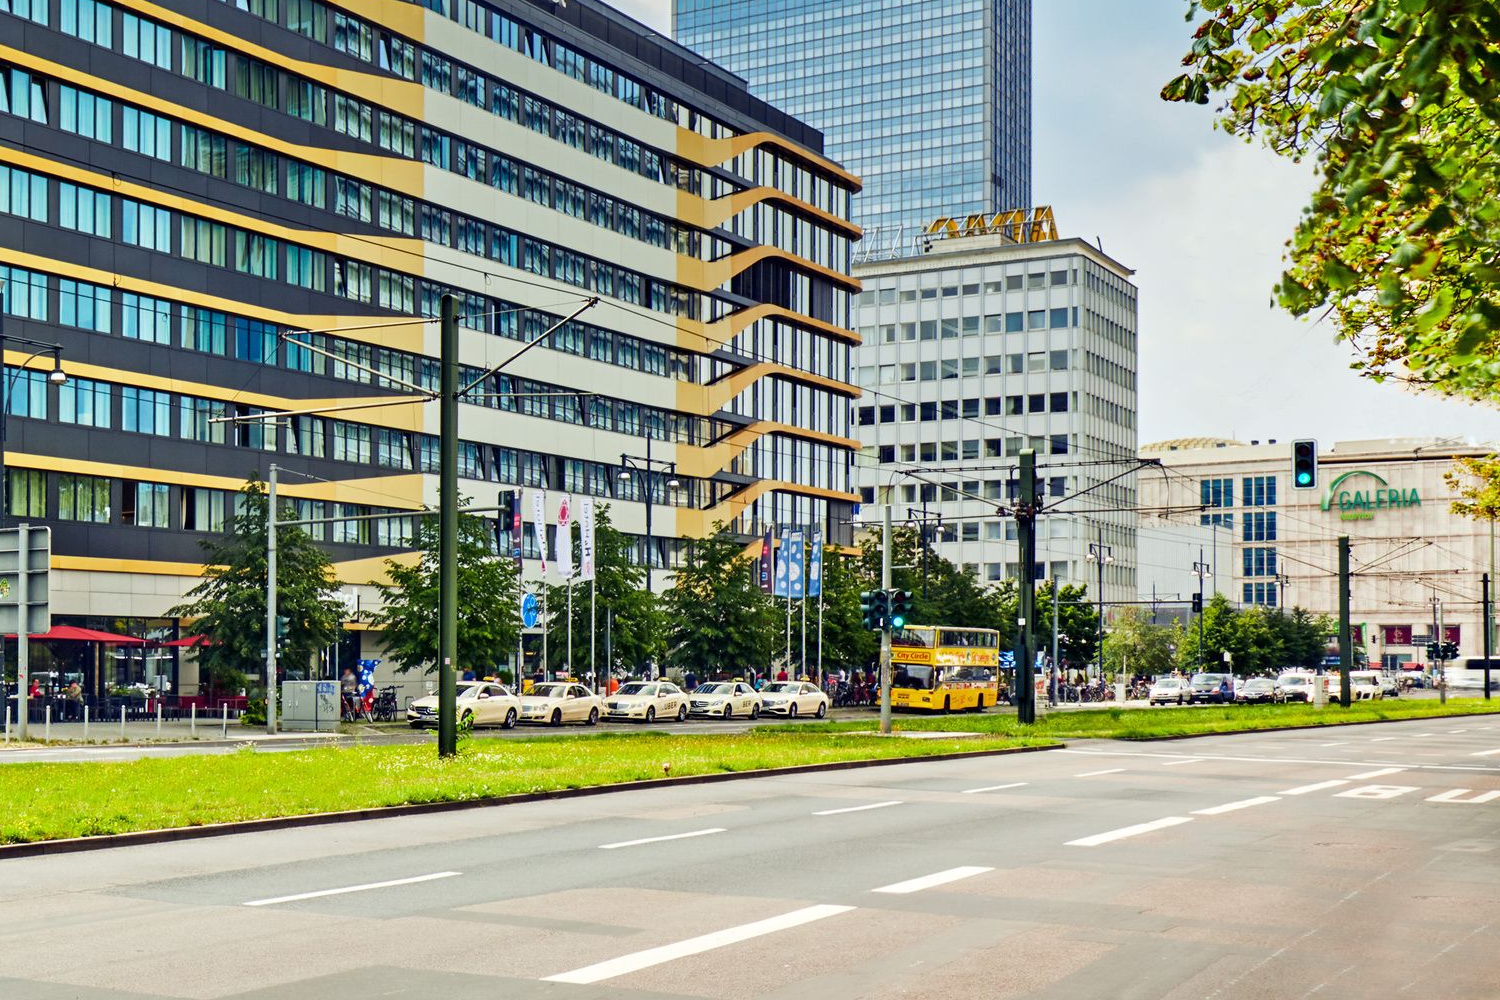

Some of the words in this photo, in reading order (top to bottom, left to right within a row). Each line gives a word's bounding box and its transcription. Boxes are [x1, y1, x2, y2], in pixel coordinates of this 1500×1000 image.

[1339, 488, 1422, 511] GALERIA
[897, 652, 910, 661] City
[910, 652, 928, 660] Circle
